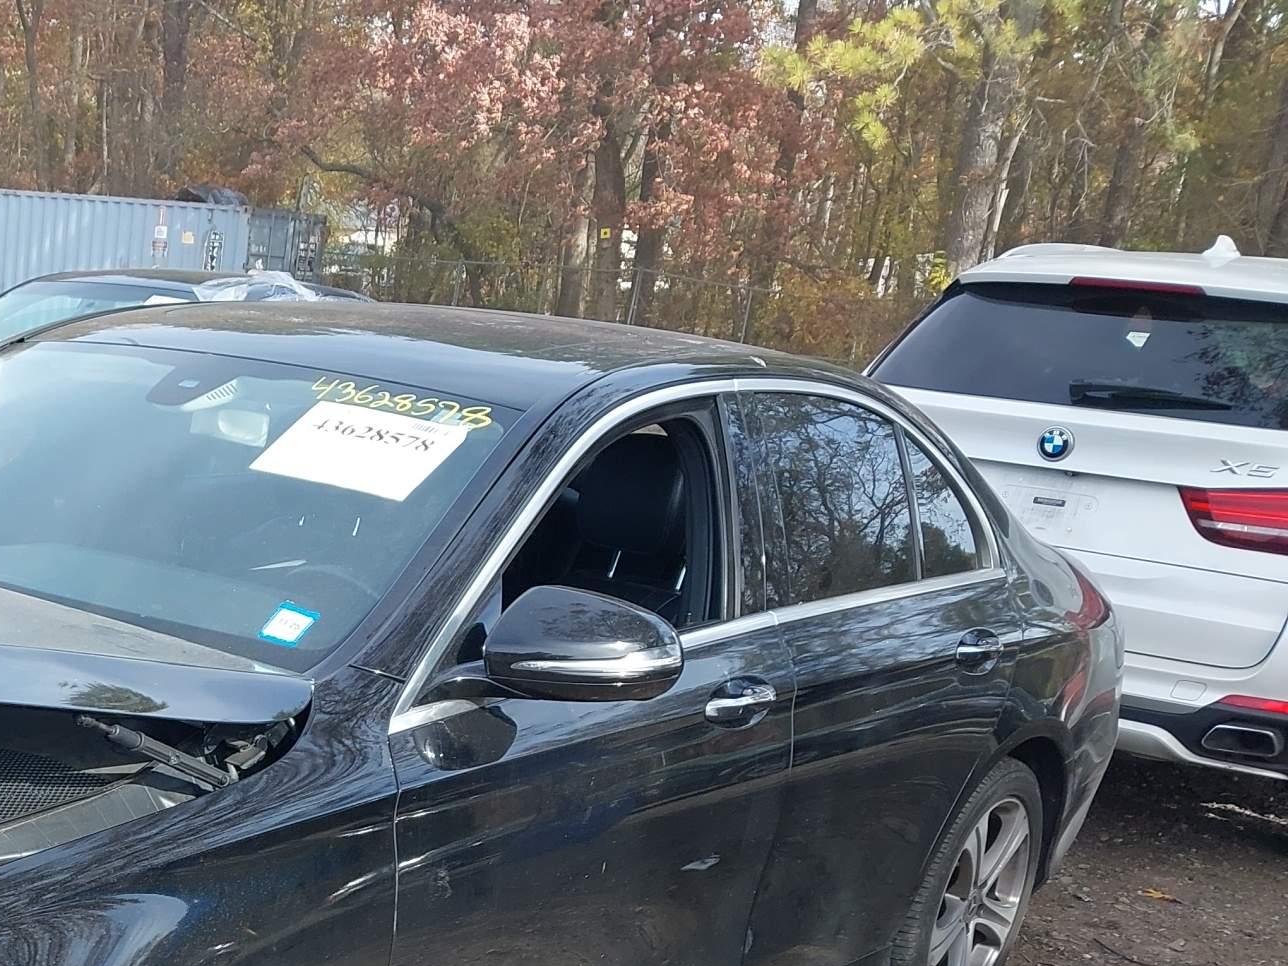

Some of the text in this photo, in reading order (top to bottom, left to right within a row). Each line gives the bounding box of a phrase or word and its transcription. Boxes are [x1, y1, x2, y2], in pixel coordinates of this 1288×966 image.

[311, 376, 493, 430] 43628578
[313, 418, 435, 452] 43628578
[1209, 458, 1280, 478] X5
